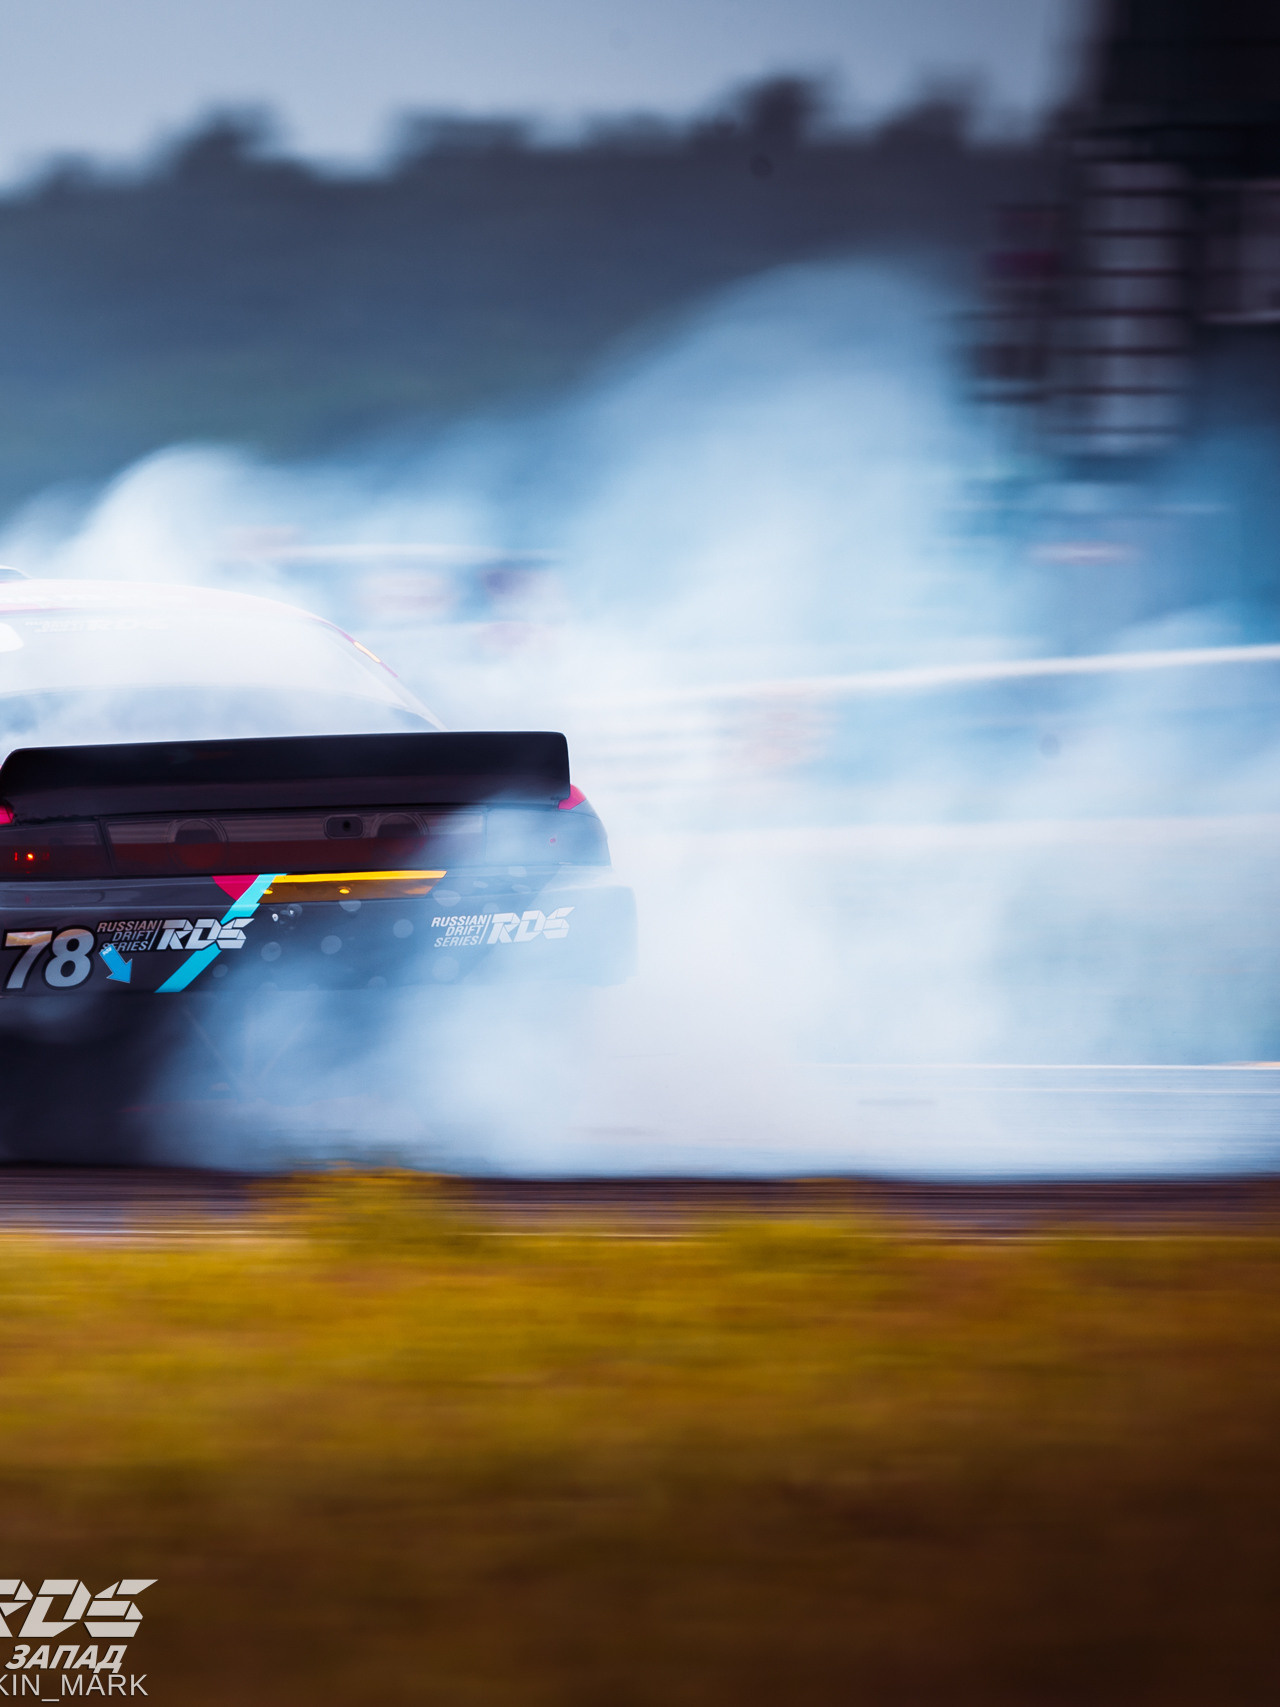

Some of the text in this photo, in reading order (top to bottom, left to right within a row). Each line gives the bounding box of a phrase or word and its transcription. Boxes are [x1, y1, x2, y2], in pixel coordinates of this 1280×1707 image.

[96, 920, 158, 933] RUSSIAN
[431, 914, 488, 928] RUSSIAN
[487, 906, 575, 945] RDS
[112, 930, 154, 942] DRIFT
[156, 918, 255, 950] RDS
[445, 924, 484, 937] DRIFT
[434, 935, 480, 948] SERIES
[5, 928, 95, 989] 78
